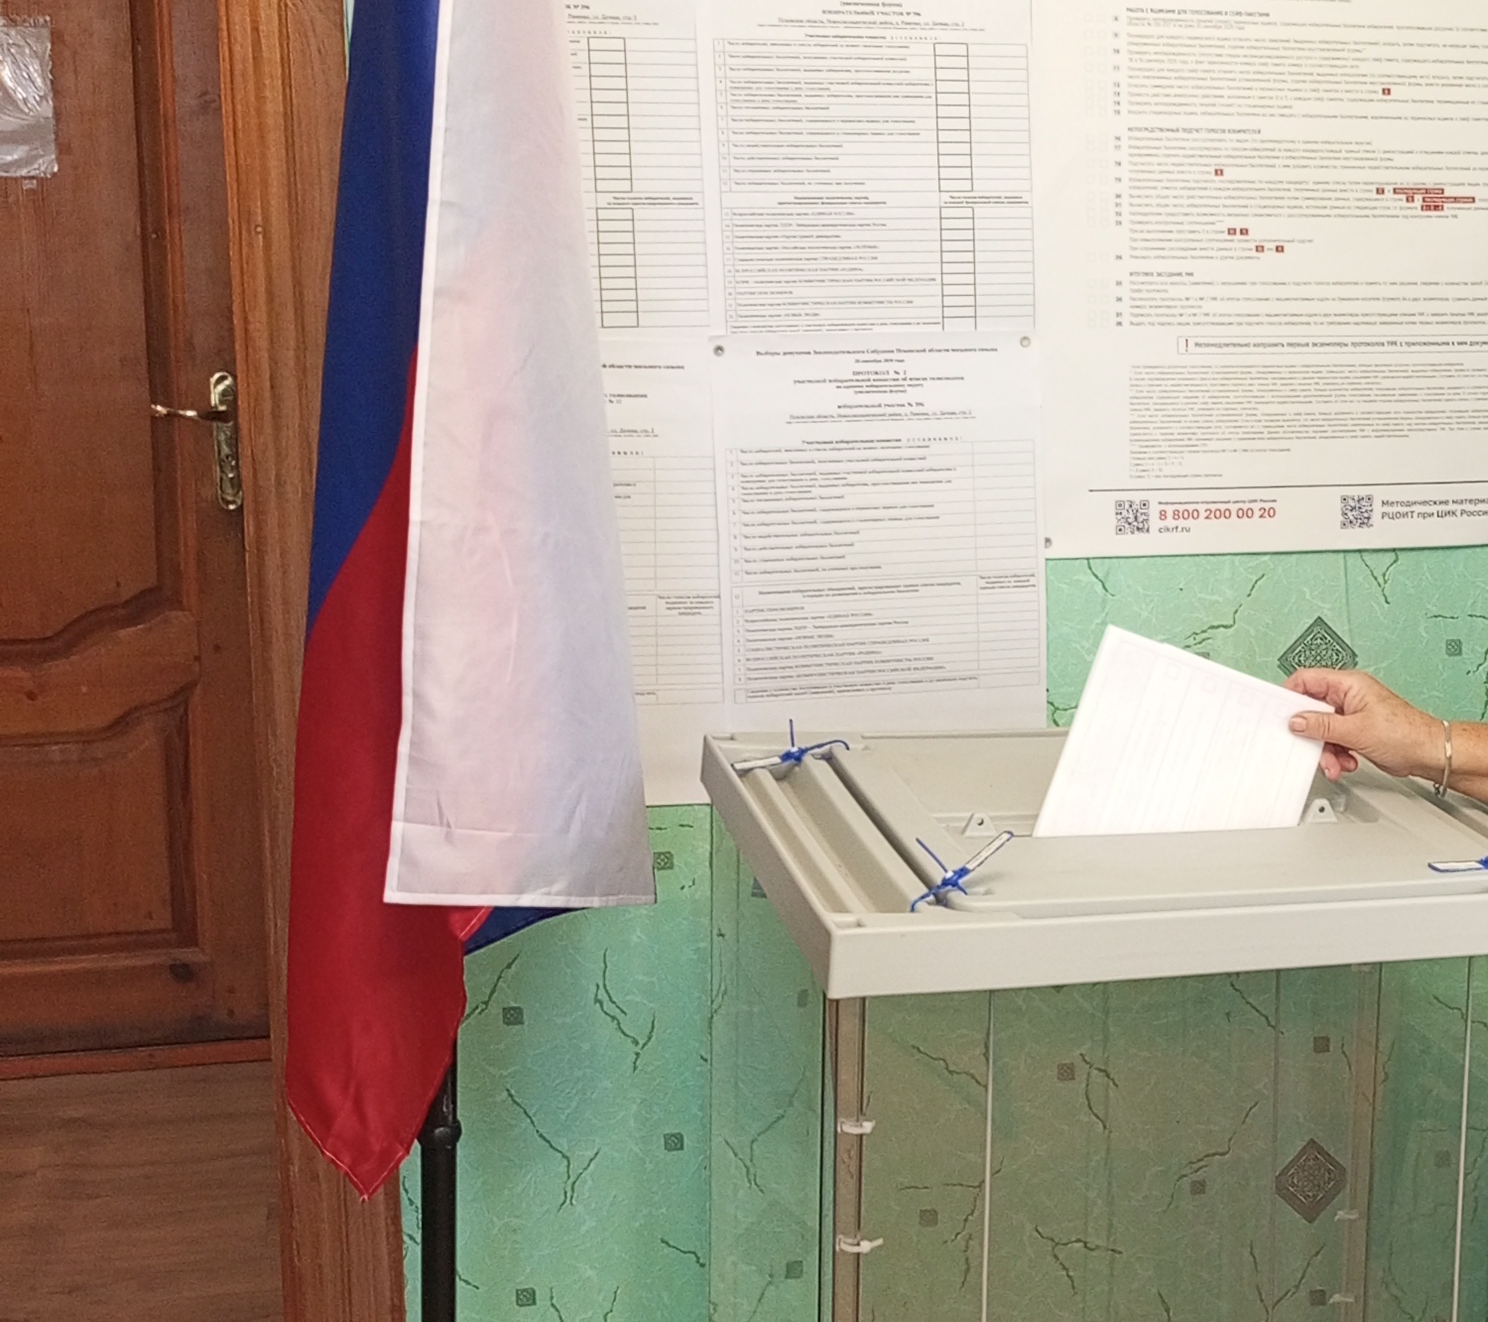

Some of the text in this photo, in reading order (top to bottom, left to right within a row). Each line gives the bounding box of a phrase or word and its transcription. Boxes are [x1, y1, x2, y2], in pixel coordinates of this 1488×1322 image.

[1381, 498, 1450, 508] Методические
[1159, 506, 1276, 521] 8 800 200 00 20
[1381, 510, 1414, 520] РЦОИТ
[1417, 511, 1434, 520] при
[1436, 509, 1458, 519] ЦИК
[1158, 525, 1191, 534] cikrf.ru
